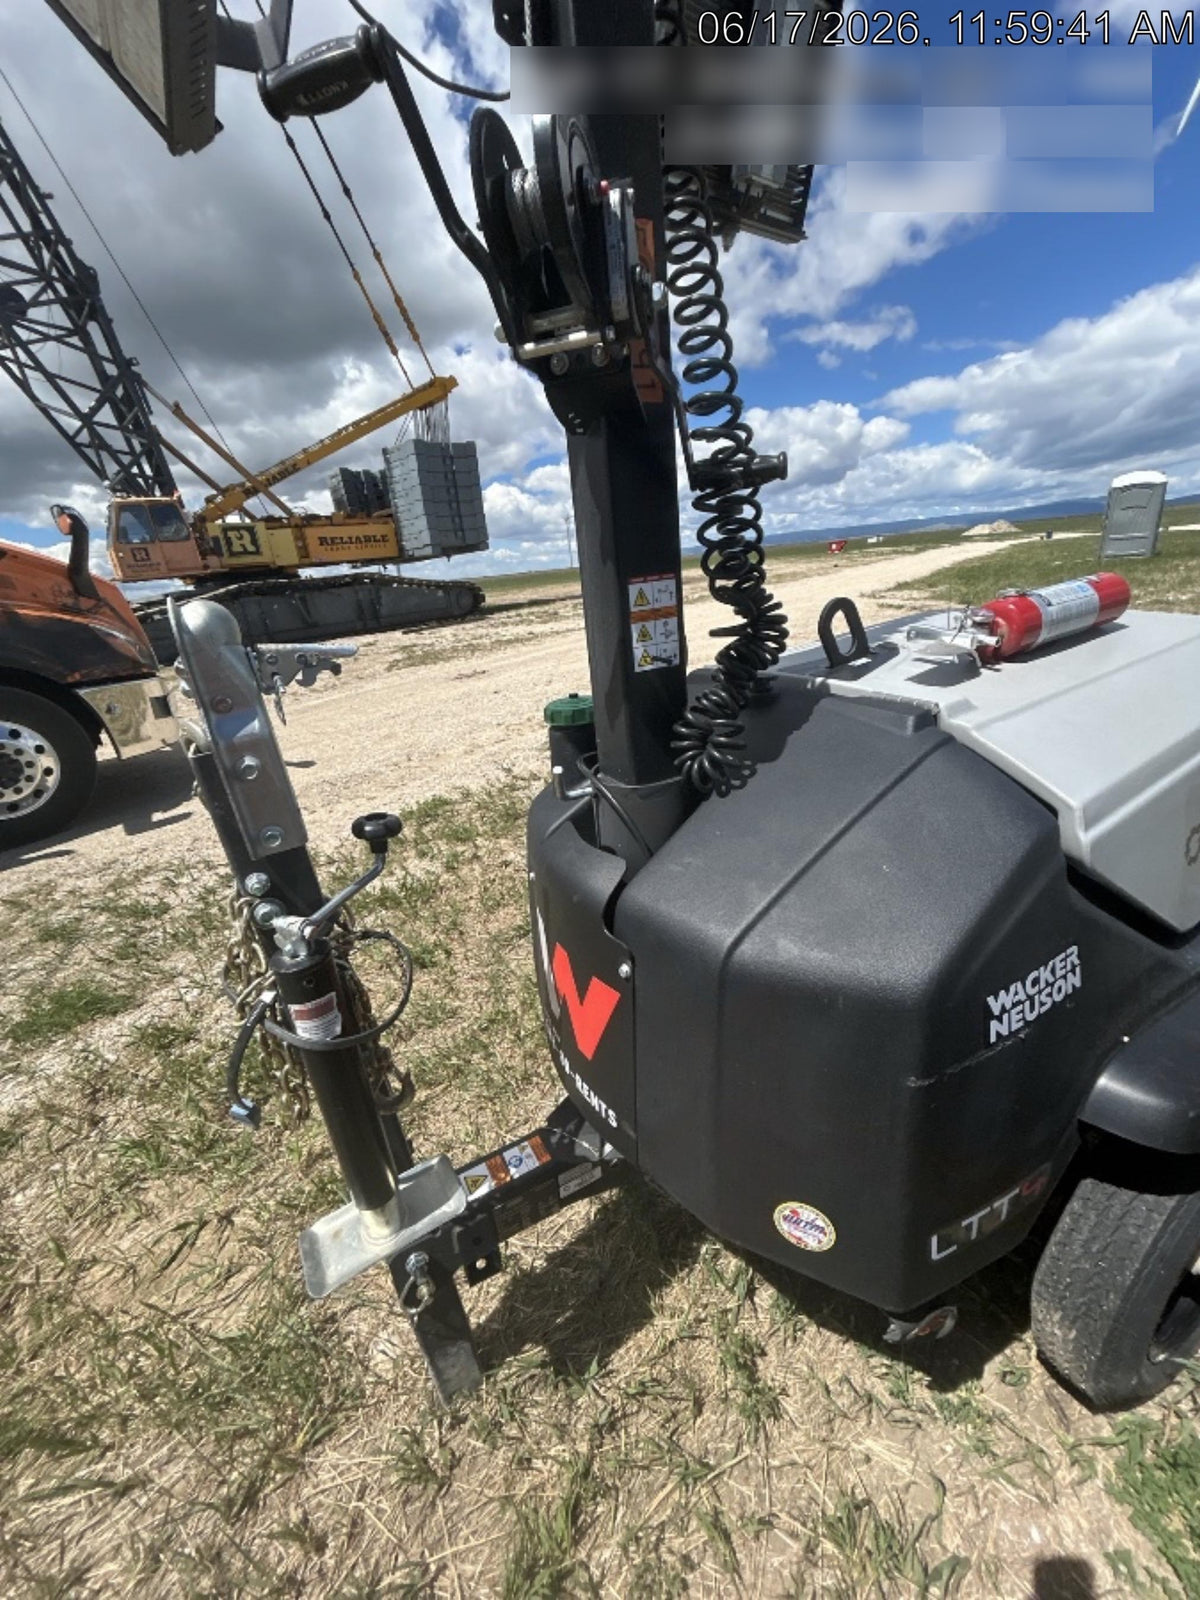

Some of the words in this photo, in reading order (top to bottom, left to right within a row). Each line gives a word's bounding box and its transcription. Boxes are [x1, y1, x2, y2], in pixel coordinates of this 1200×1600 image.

[317, 534, 390, 547] RELIABLE
[986, 945, 1080, 1016] WACKER
[989, 965, 1082, 1044] NEUSON
